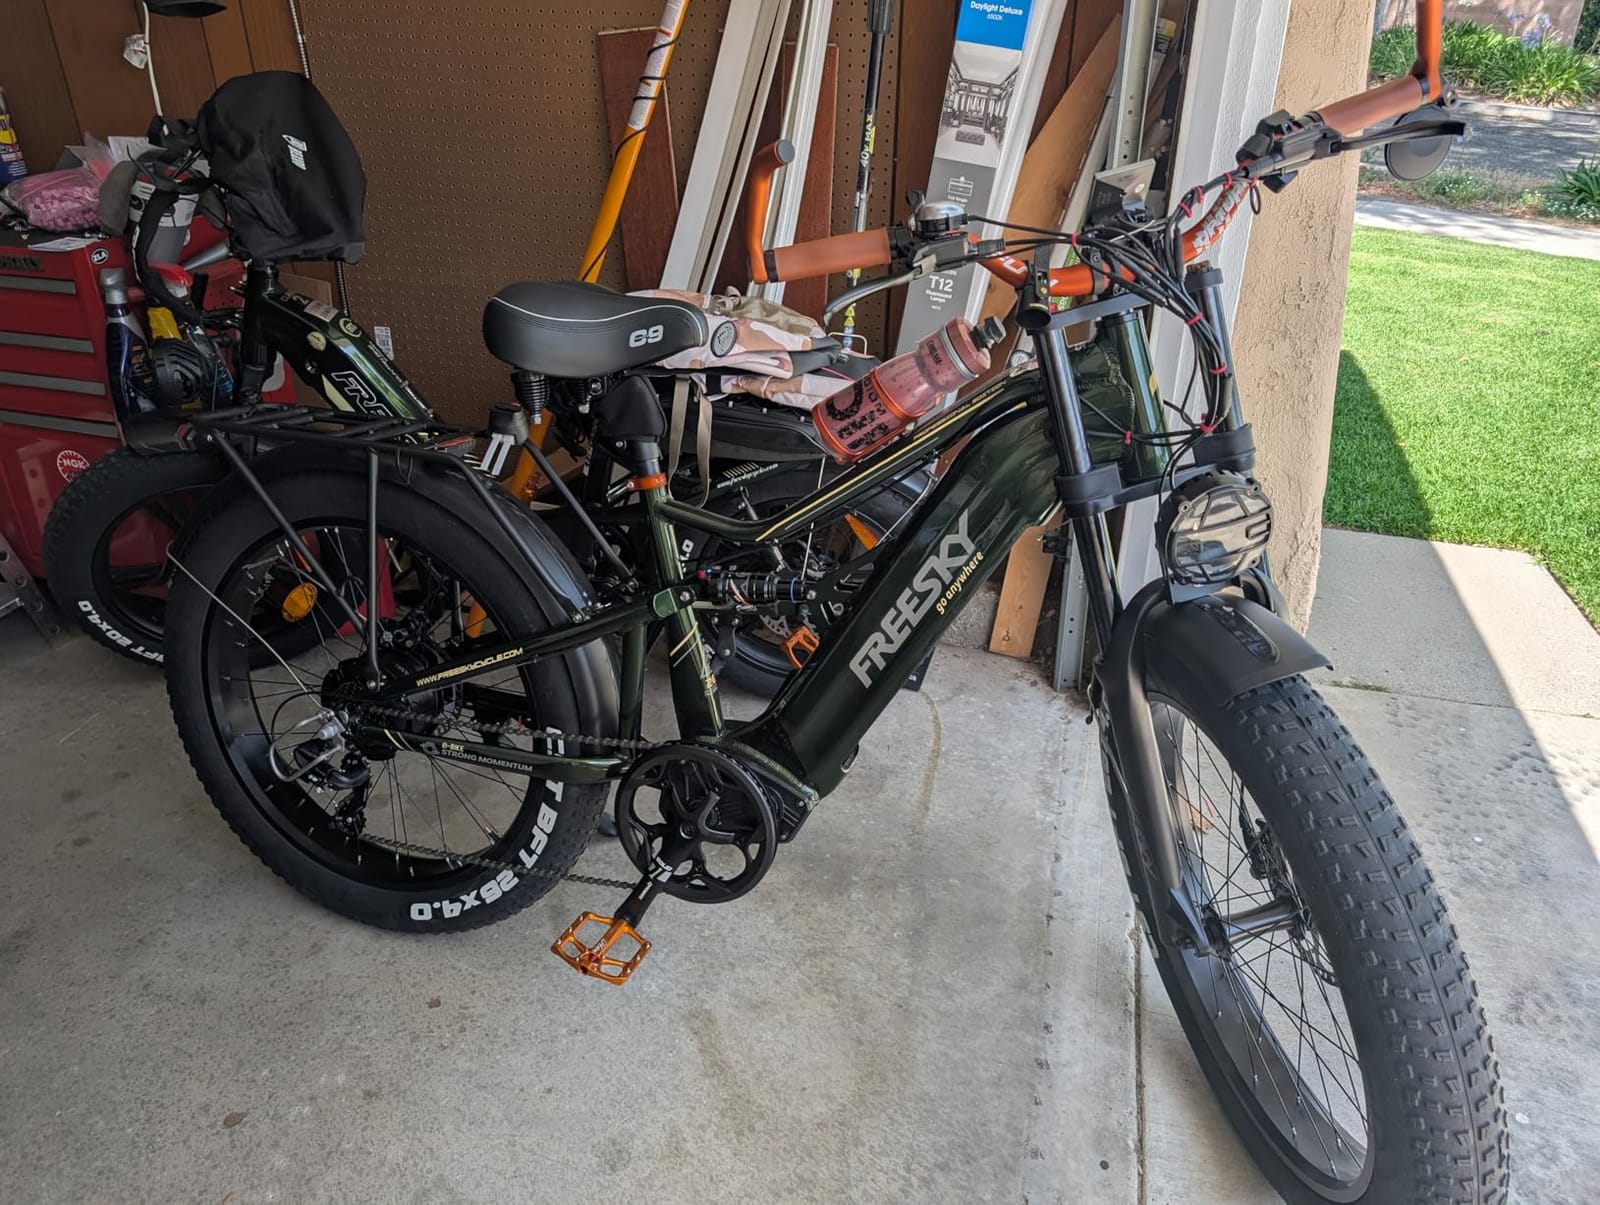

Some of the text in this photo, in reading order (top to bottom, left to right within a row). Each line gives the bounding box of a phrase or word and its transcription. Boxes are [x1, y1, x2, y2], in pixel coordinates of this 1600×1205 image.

[970, 1, 1023, 15] Daylight Deluxe
[864, 113, 873, 141] MAX
[929, 275, 954, 292] T12
[629, 325, 664, 348] 69
[62, 458, 87, 470] NGK
[935, 551, 984, 615] go anywhere
[849, 508, 976, 689] FREESKY
[441, 749, 533, 772] STRONG MOMENTUM
[518, 802, 558, 869] BFT
